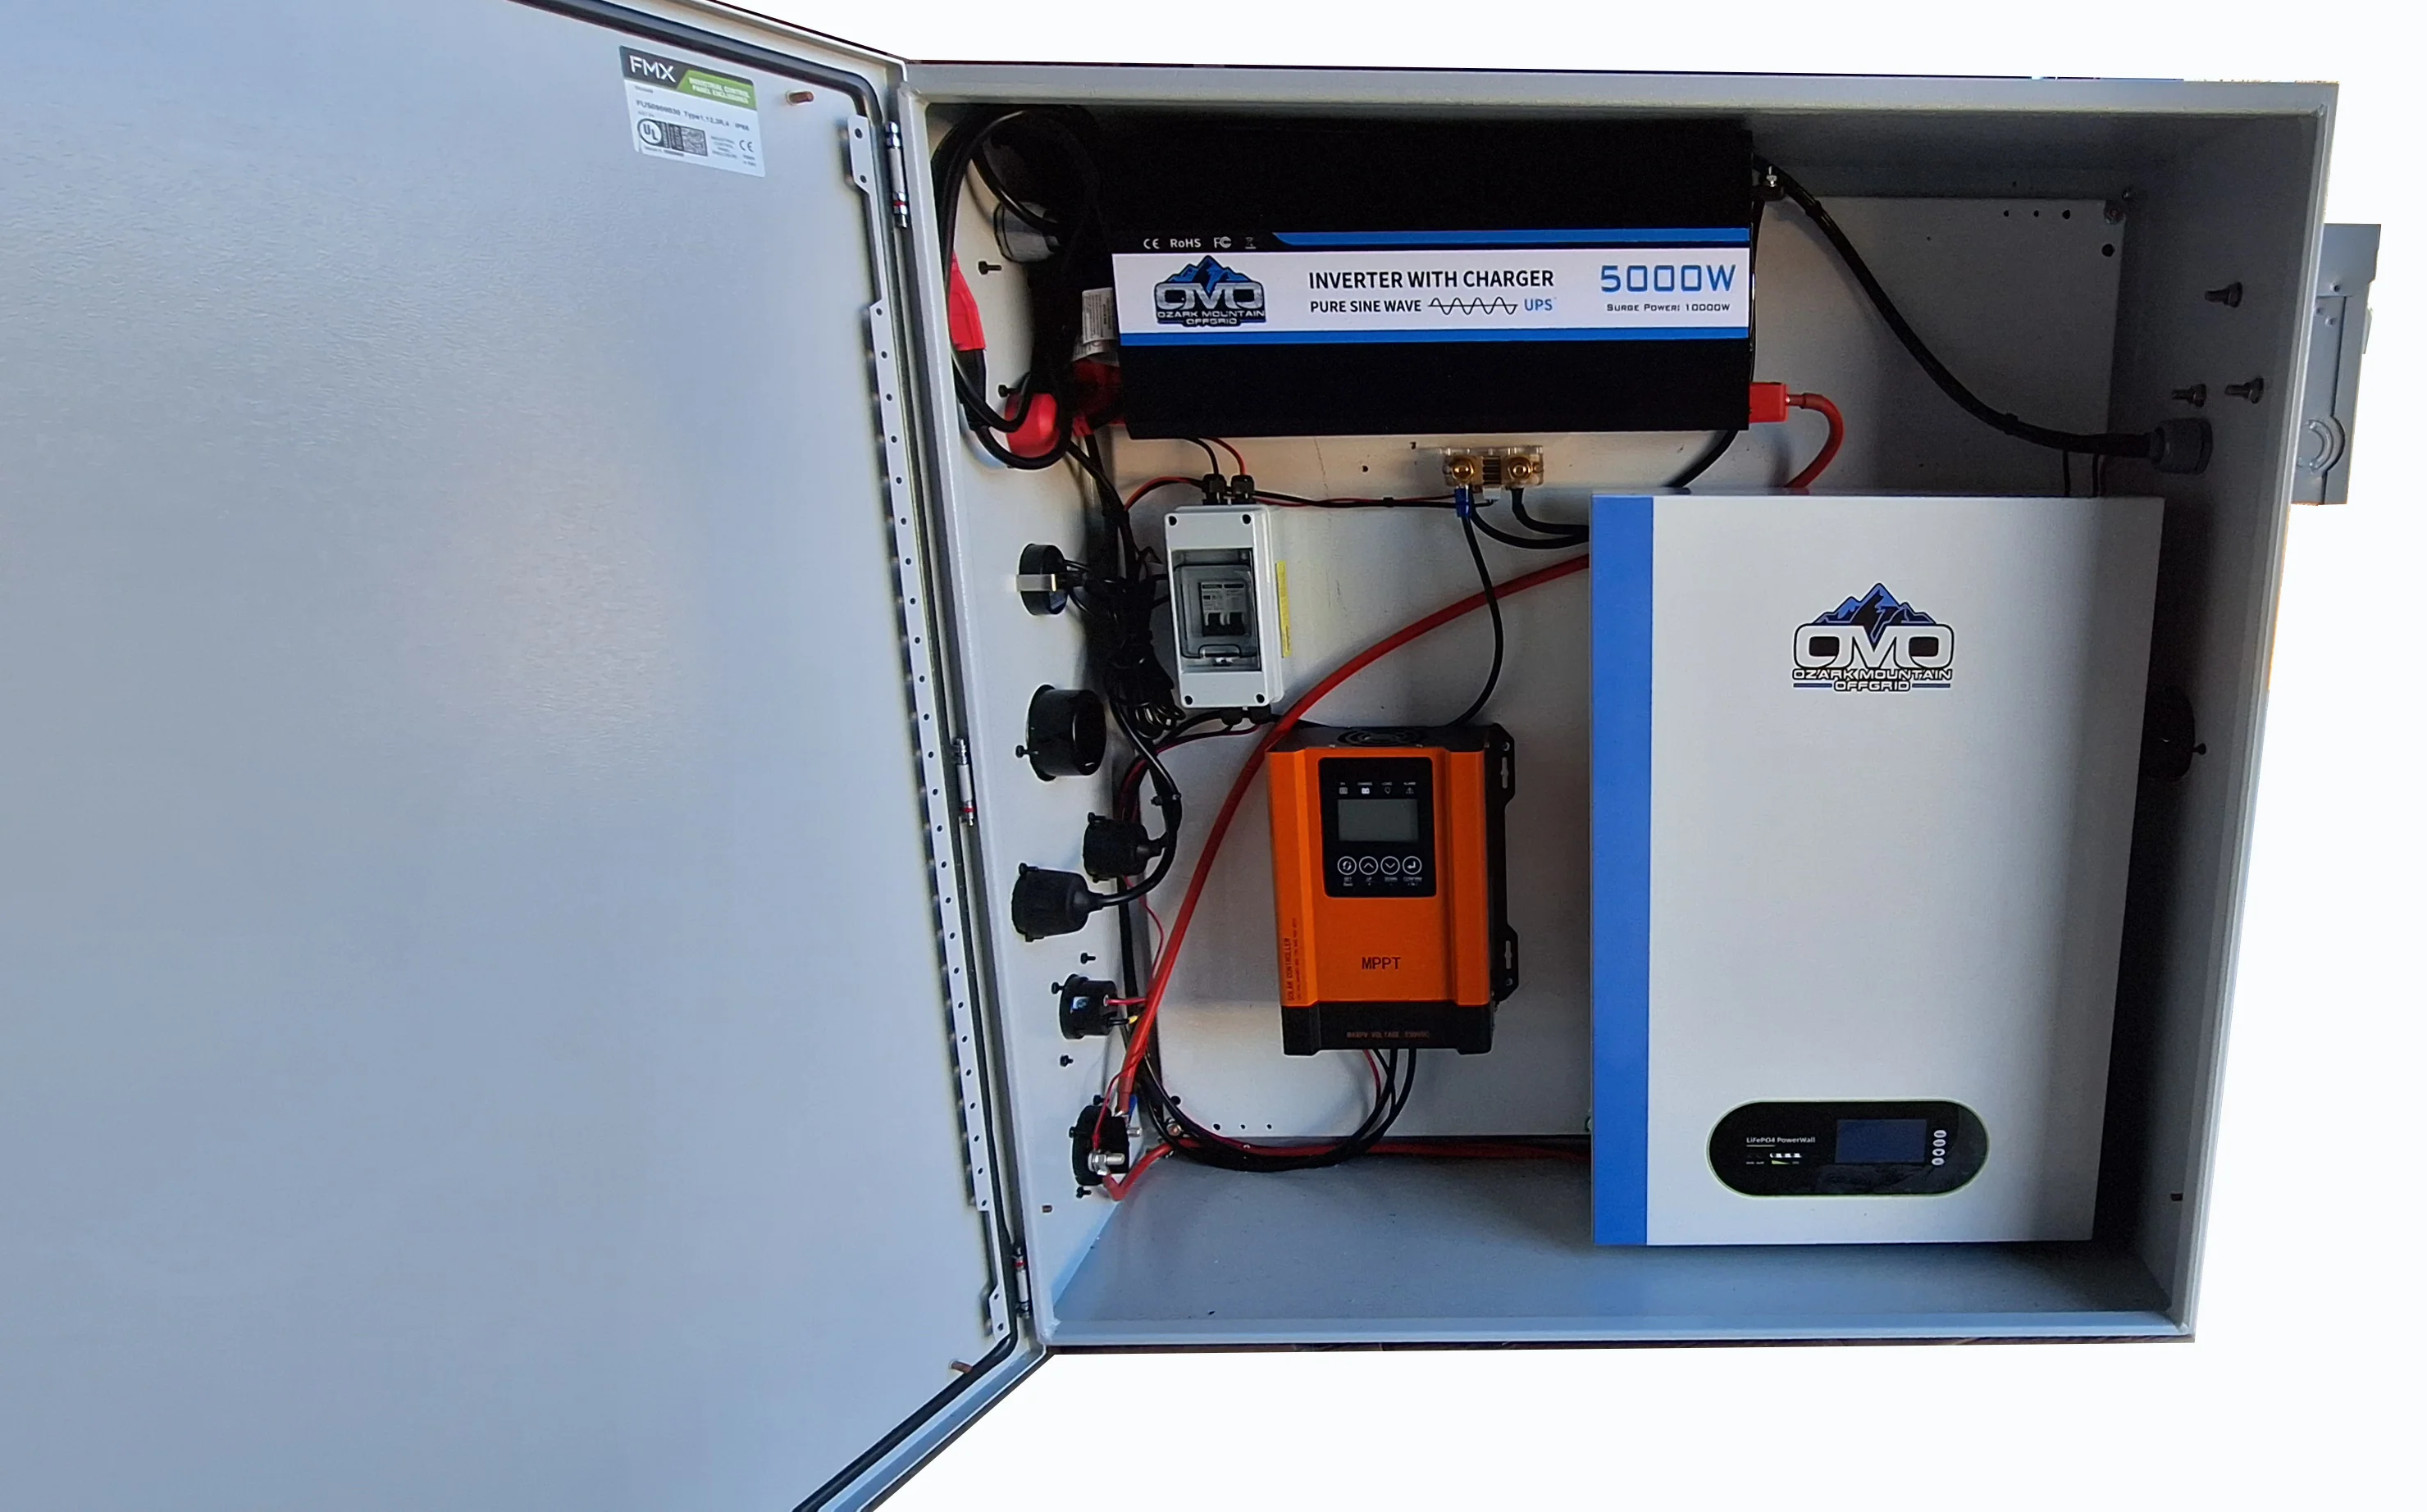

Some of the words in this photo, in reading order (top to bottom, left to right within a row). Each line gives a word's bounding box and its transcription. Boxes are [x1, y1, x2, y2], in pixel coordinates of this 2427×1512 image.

[628, 55, 677, 83] FMX
[643, 123, 659, 141] UL
[739, 139, 755, 153] CE
[1143, 239, 1160, 249] CE
[1170, 238, 1202, 248] RoHS
[1309, 271, 1403, 289] INVERTER
[1407, 271, 1458, 288] WITH
[1463, 270, 1554, 287] CHARGER
[1600, 264, 1736, 293] 5000W
[1310, 300, 1346, 313] PURE
[1350, 300, 1381, 312] SINE
[1384, 299, 1422, 312] WAVE
[1524, 298, 1553, 312] UPS
[1686, 303, 1731, 312] 10000W
[1157, 310, 1198, 318] OZARK
[1793, 668, 1858, 681] OZARK
[1858, 668, 1953, 681] MOUNTAIN
[1834, 681, 1910, 691] OFFGRID
[1283, 937, 1293, 979] CONTROLLER
[1362, 956, 1402, 970] MPPT
[1286, 981, 1295, 1001] SOLAR
